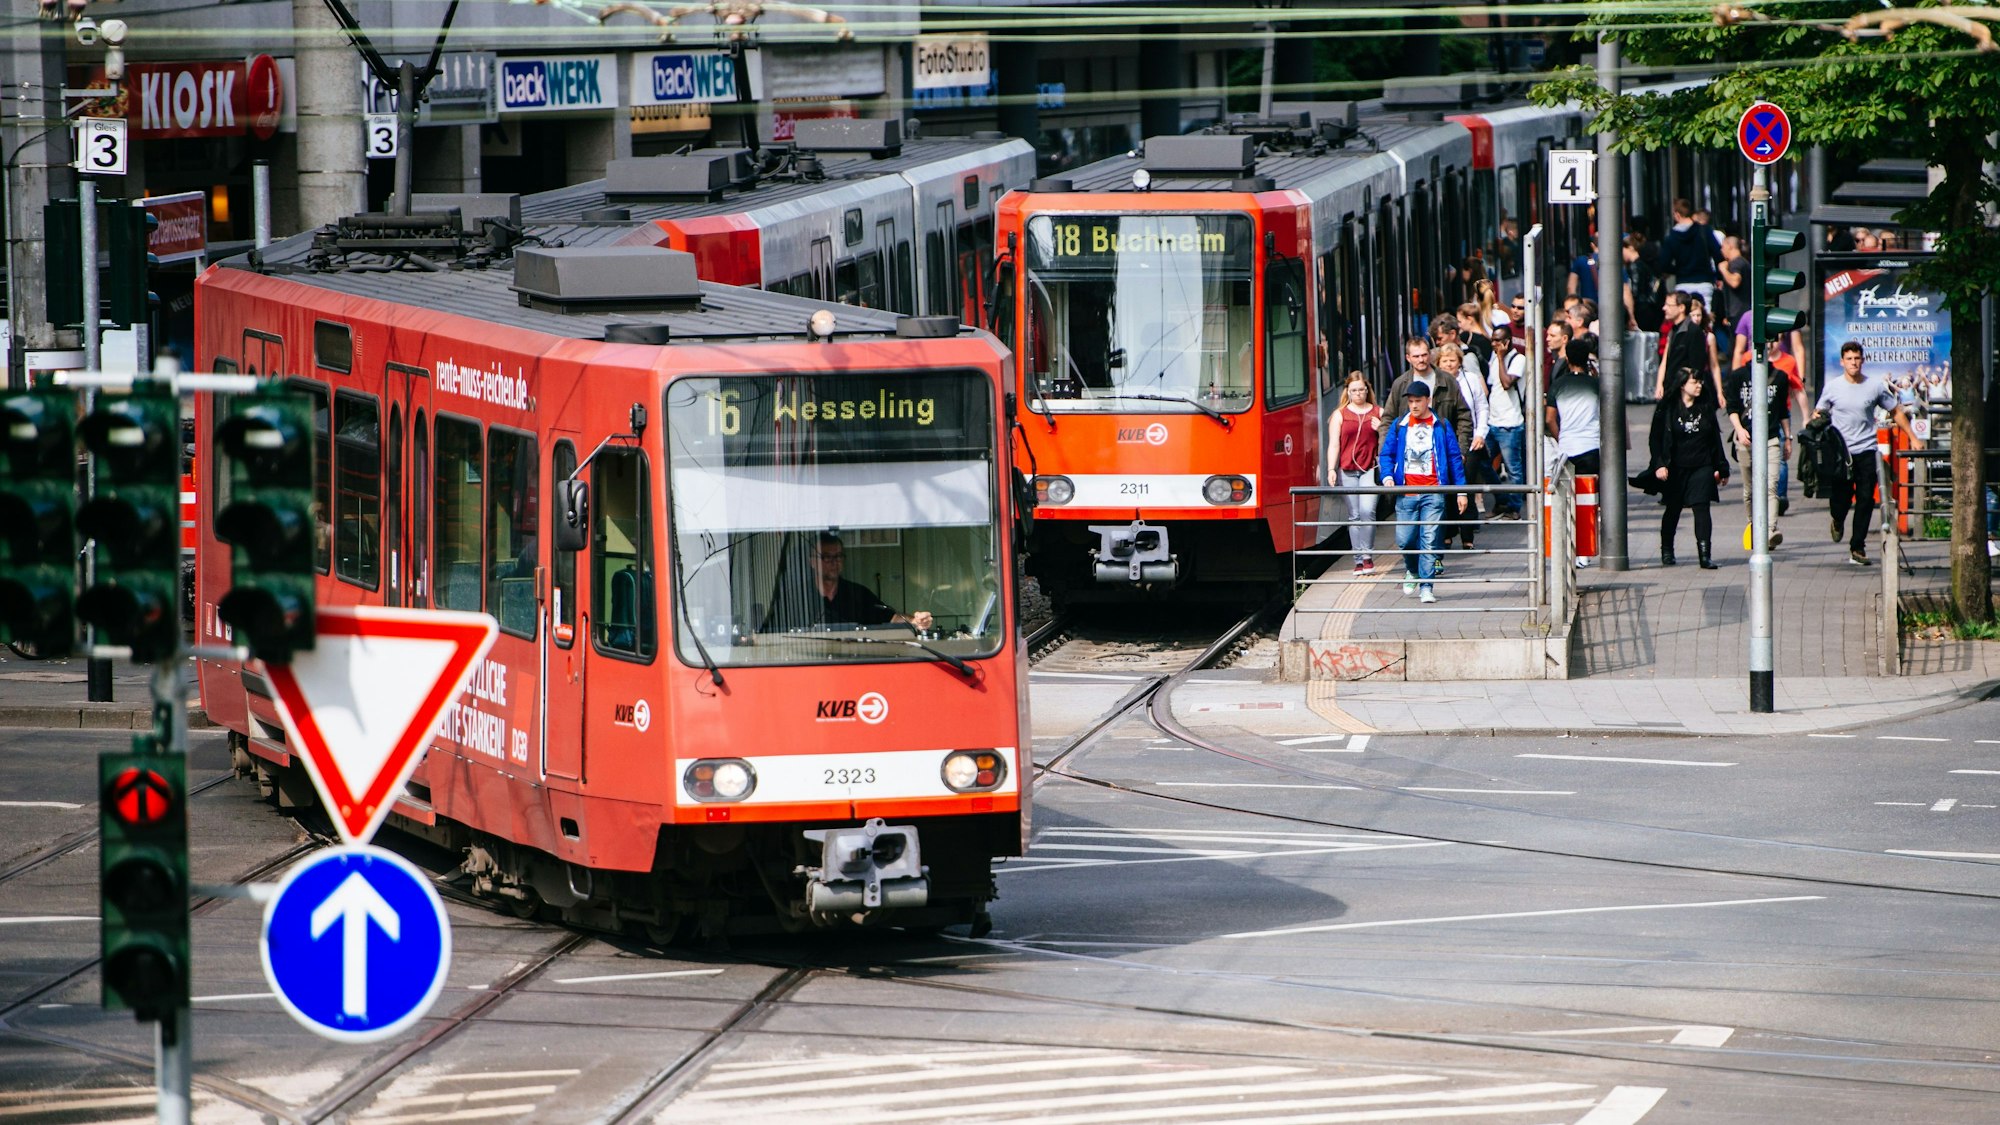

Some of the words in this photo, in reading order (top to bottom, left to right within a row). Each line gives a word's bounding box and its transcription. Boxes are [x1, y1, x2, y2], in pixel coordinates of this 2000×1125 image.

[919, 44, 985, 75] FotoStudio
[653, 55, 735, 99] backWER
[141, 70, 235, 130] KIOSK
[95, 122, 117, 132] Gleis
[375, 127, 394, 154] 3
[93, 134, 118, 167] 3
[1558, 156, 1579, 164] Gleis
[1560, 167, 1580, 196] 4
[1055, 224, 1081, 256] 18
[1092, 225, 1226, 253] Buchheim
[1825, 272, 1854, 296] NEU!
[436, 356, 528, 411] rente-muss-reichen.de
[705, 388, 741, 436] 16
[774, 387, 935, 426] Wesseling
[1117, 428, 1146, 441] KVB
[1120, 483, 1150, 495] 2311
[614, 703, 635, 723] KVB
[815, 700, 857, 719] KVB
[462, 698, 506, 761] STÄRKEN!
[511, 727, 528, 763] DGB
[823, 768, 877, 785] 2323
